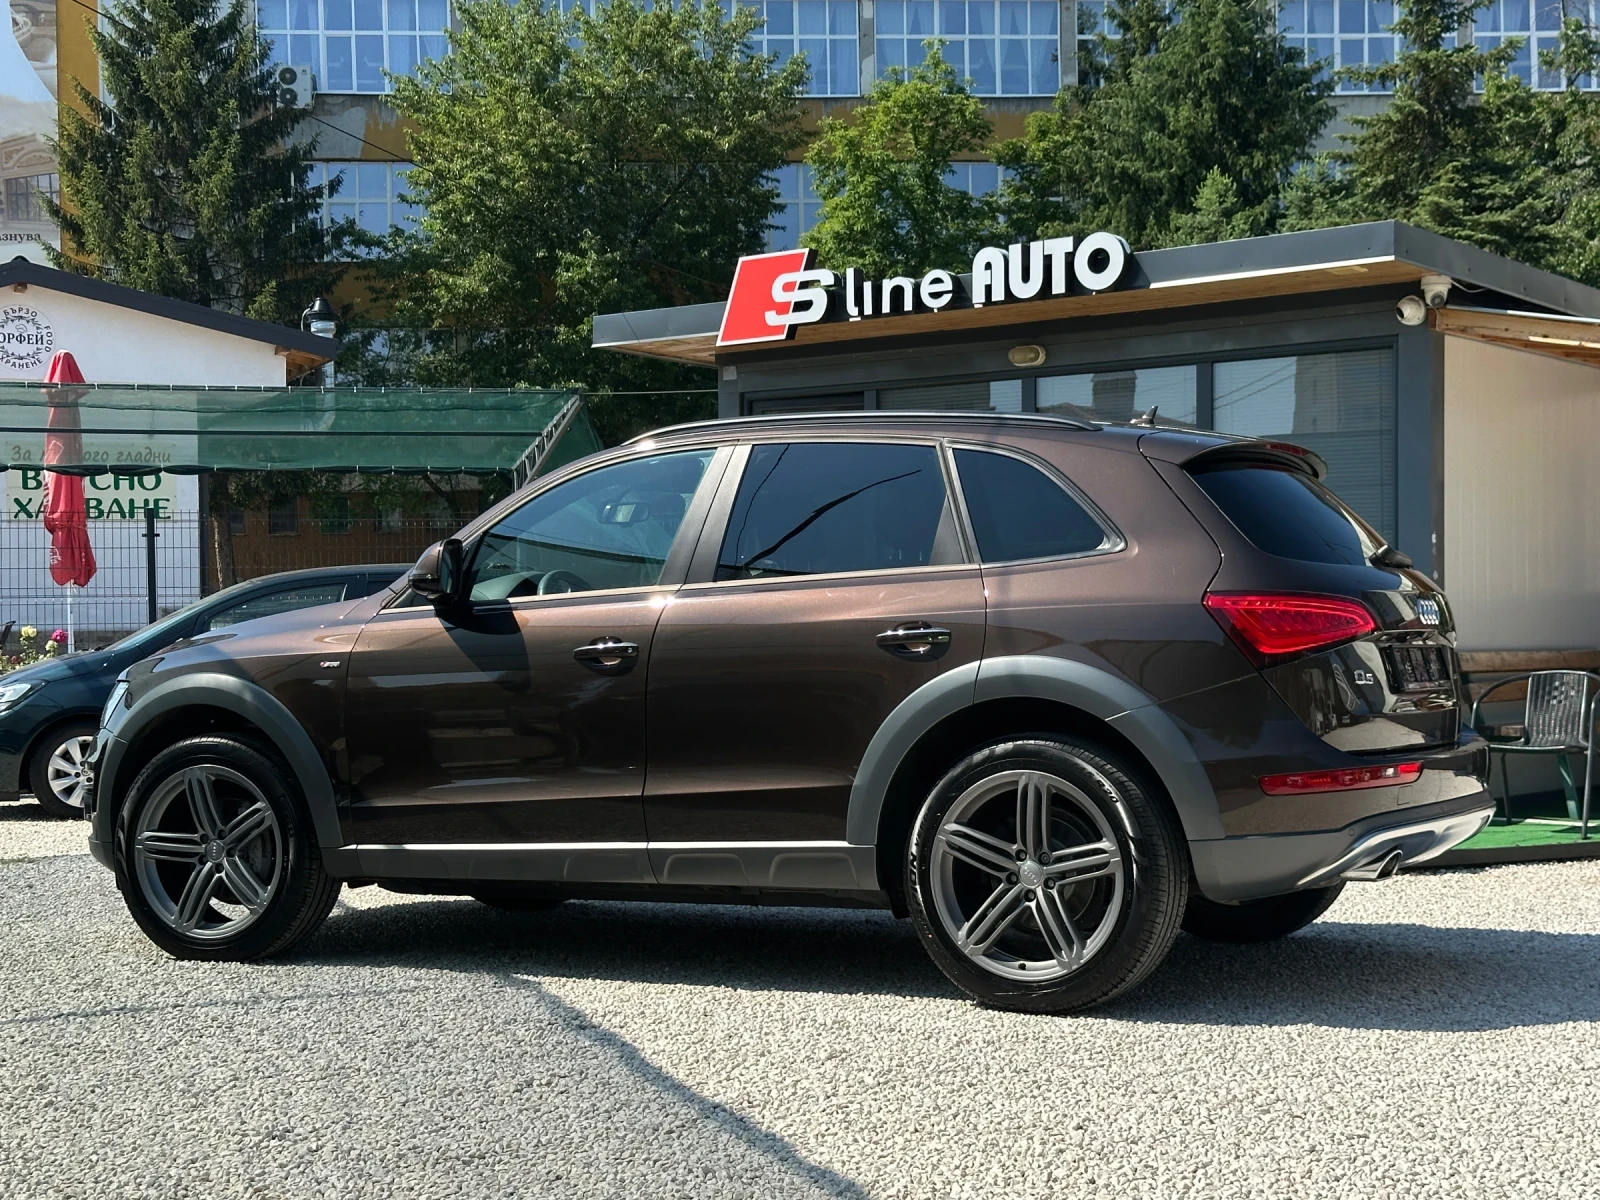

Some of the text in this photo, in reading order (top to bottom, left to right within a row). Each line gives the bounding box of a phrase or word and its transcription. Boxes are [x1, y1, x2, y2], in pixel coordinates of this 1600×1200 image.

[0, 233, 41, 243] знува
[845, 268, 954, 318] line
[972, 231, 1130, 304] AUTO
[3, 307, 38, 318] БЪРЗО
[11, 445, 32, 462] За
[116, 446, 171, 463] гладни
[21, 469, 162, 491] ВСНО
[13, 497, 171, 519] ХВАНЕ
[1353, 669, 1374, 684] Q5
